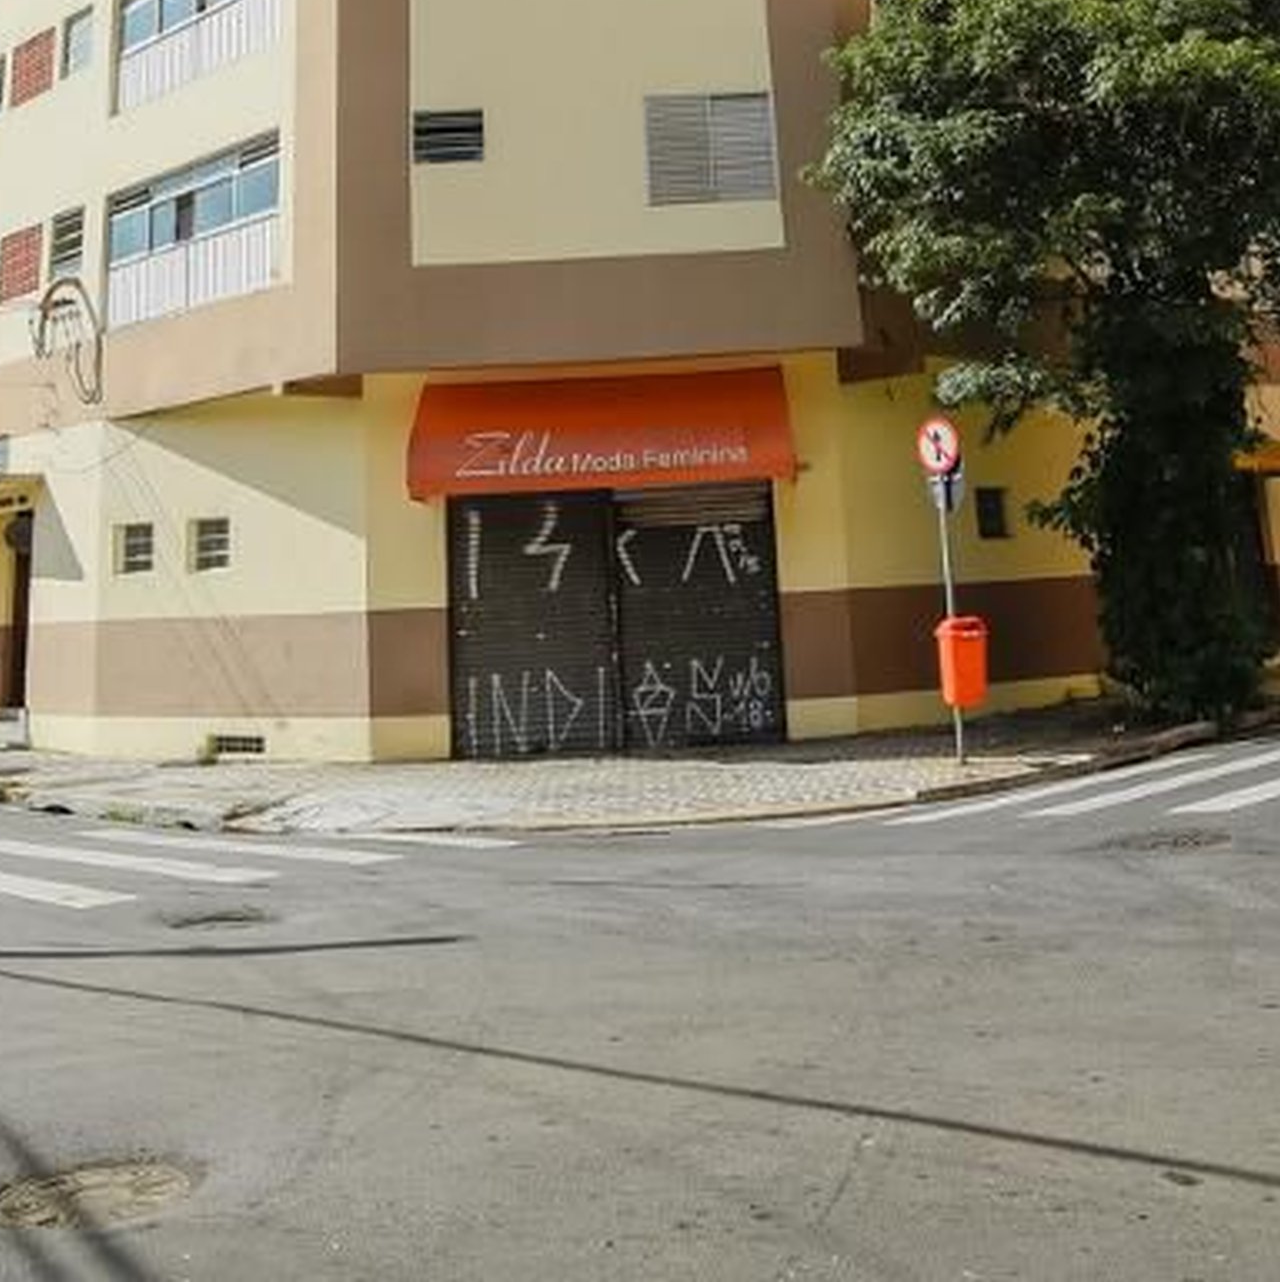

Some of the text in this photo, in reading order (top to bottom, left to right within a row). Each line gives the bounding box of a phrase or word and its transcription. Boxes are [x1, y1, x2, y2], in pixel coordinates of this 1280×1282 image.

[455, 429, 748, 477] Zilda Moda Feminina
